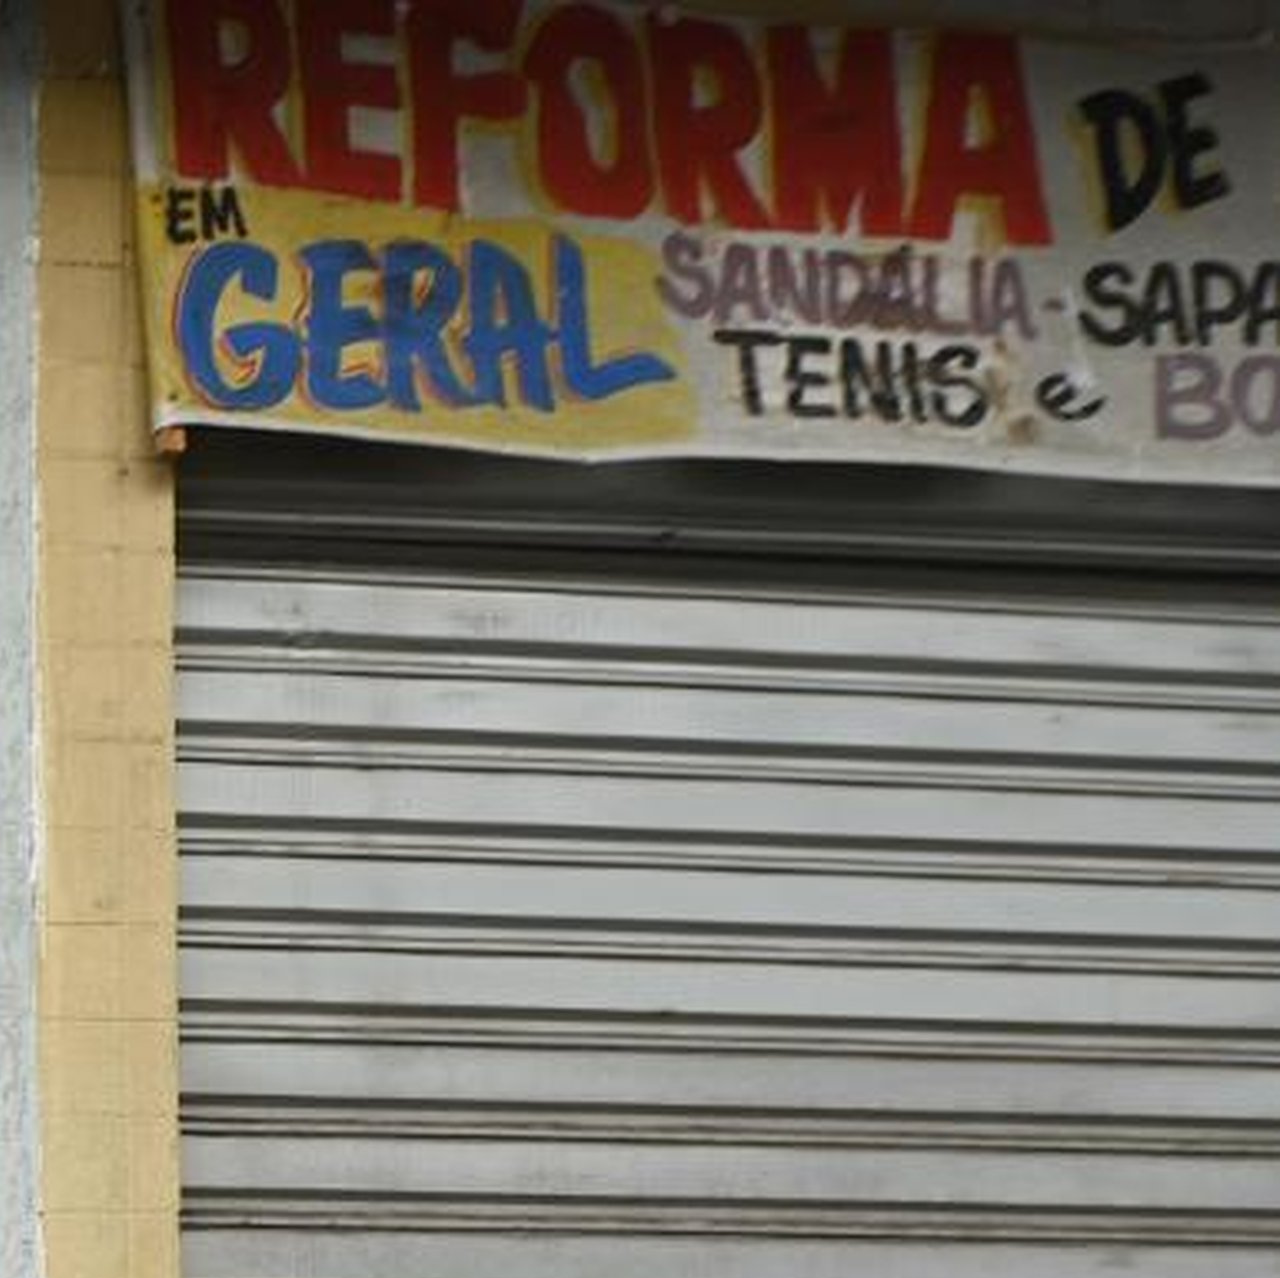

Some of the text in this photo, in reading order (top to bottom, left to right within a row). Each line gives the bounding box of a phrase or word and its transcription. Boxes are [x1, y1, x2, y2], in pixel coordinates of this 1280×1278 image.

[166, 0, 1230, 247] REFORMA DE
[165, 187, 248, 243] EM
[174, 232, 676, 412] GERAL
[713, 329, 988, 428] TENIS
[1035, 373, 1108, 421] e
